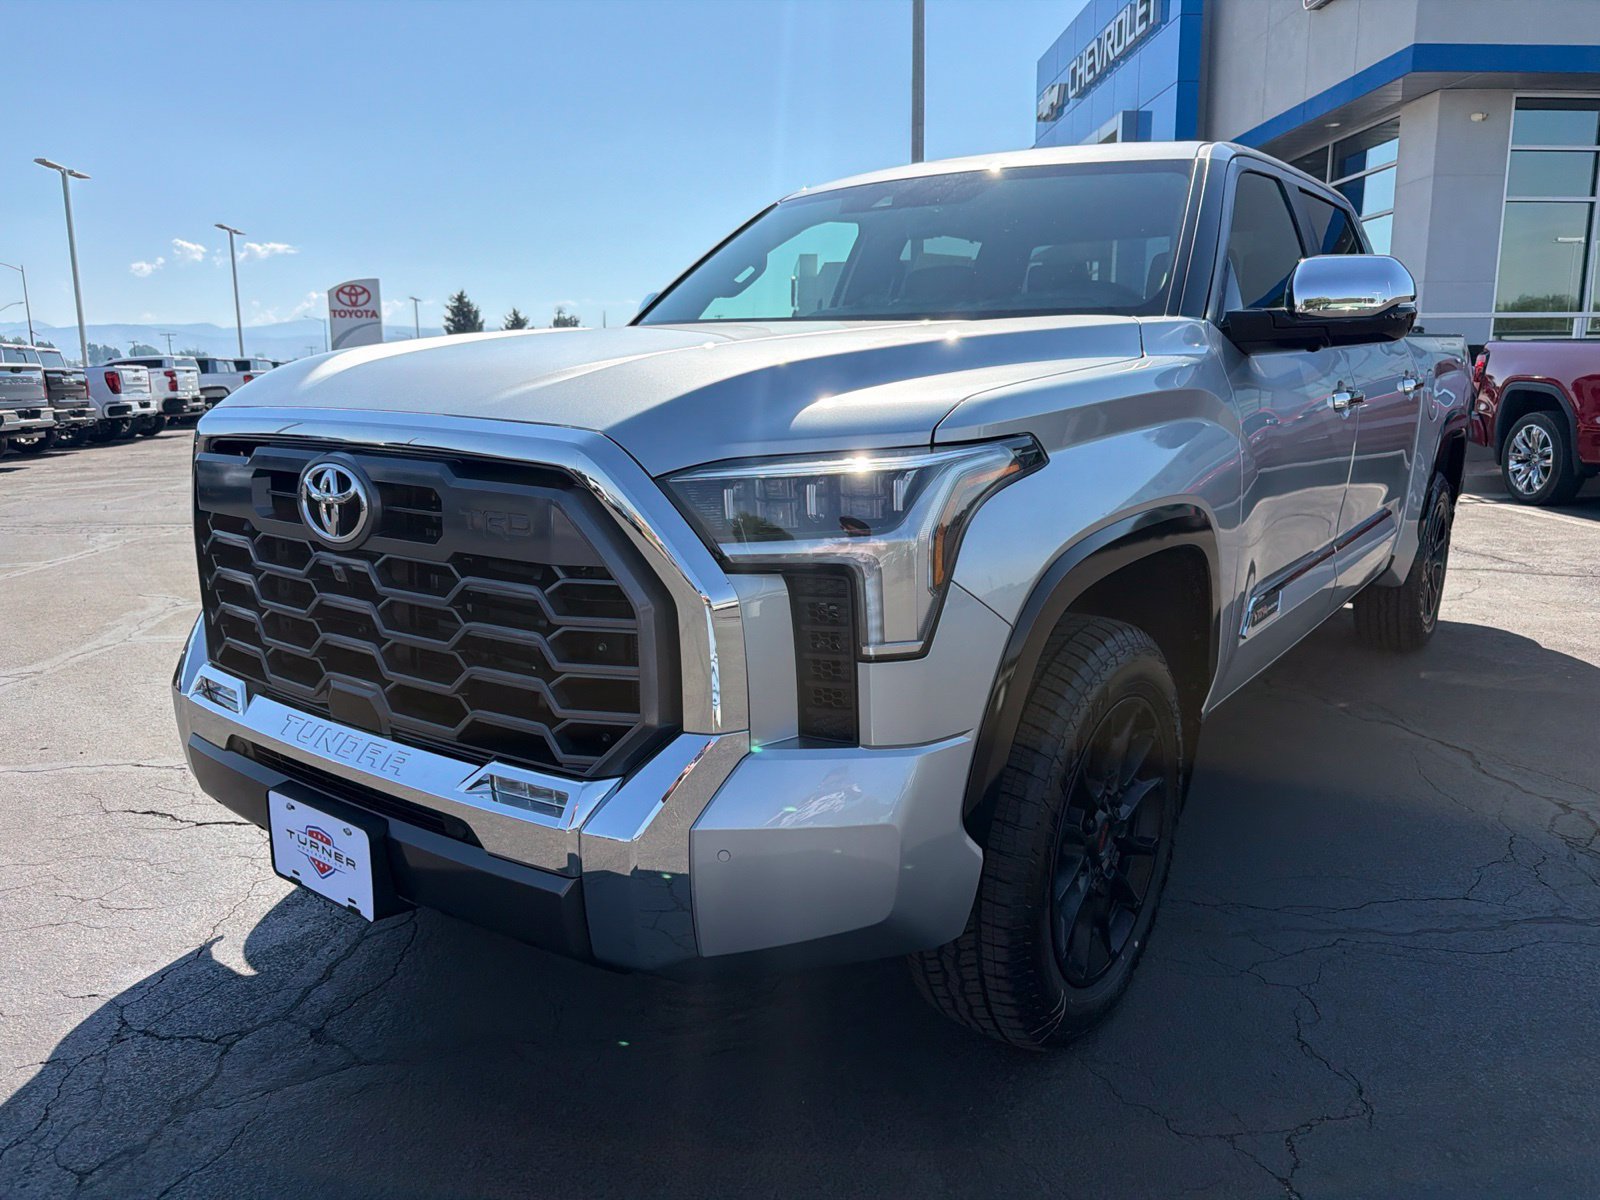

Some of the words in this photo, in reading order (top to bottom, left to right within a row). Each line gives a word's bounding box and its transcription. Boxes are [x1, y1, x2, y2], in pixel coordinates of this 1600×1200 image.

[331, 309, 379, 319] TOYOTA
[459, 509, 533, 540] TRD
[280, 713, 411, 777] TUNDRA
[286, 828, 356, 870] TURNER
